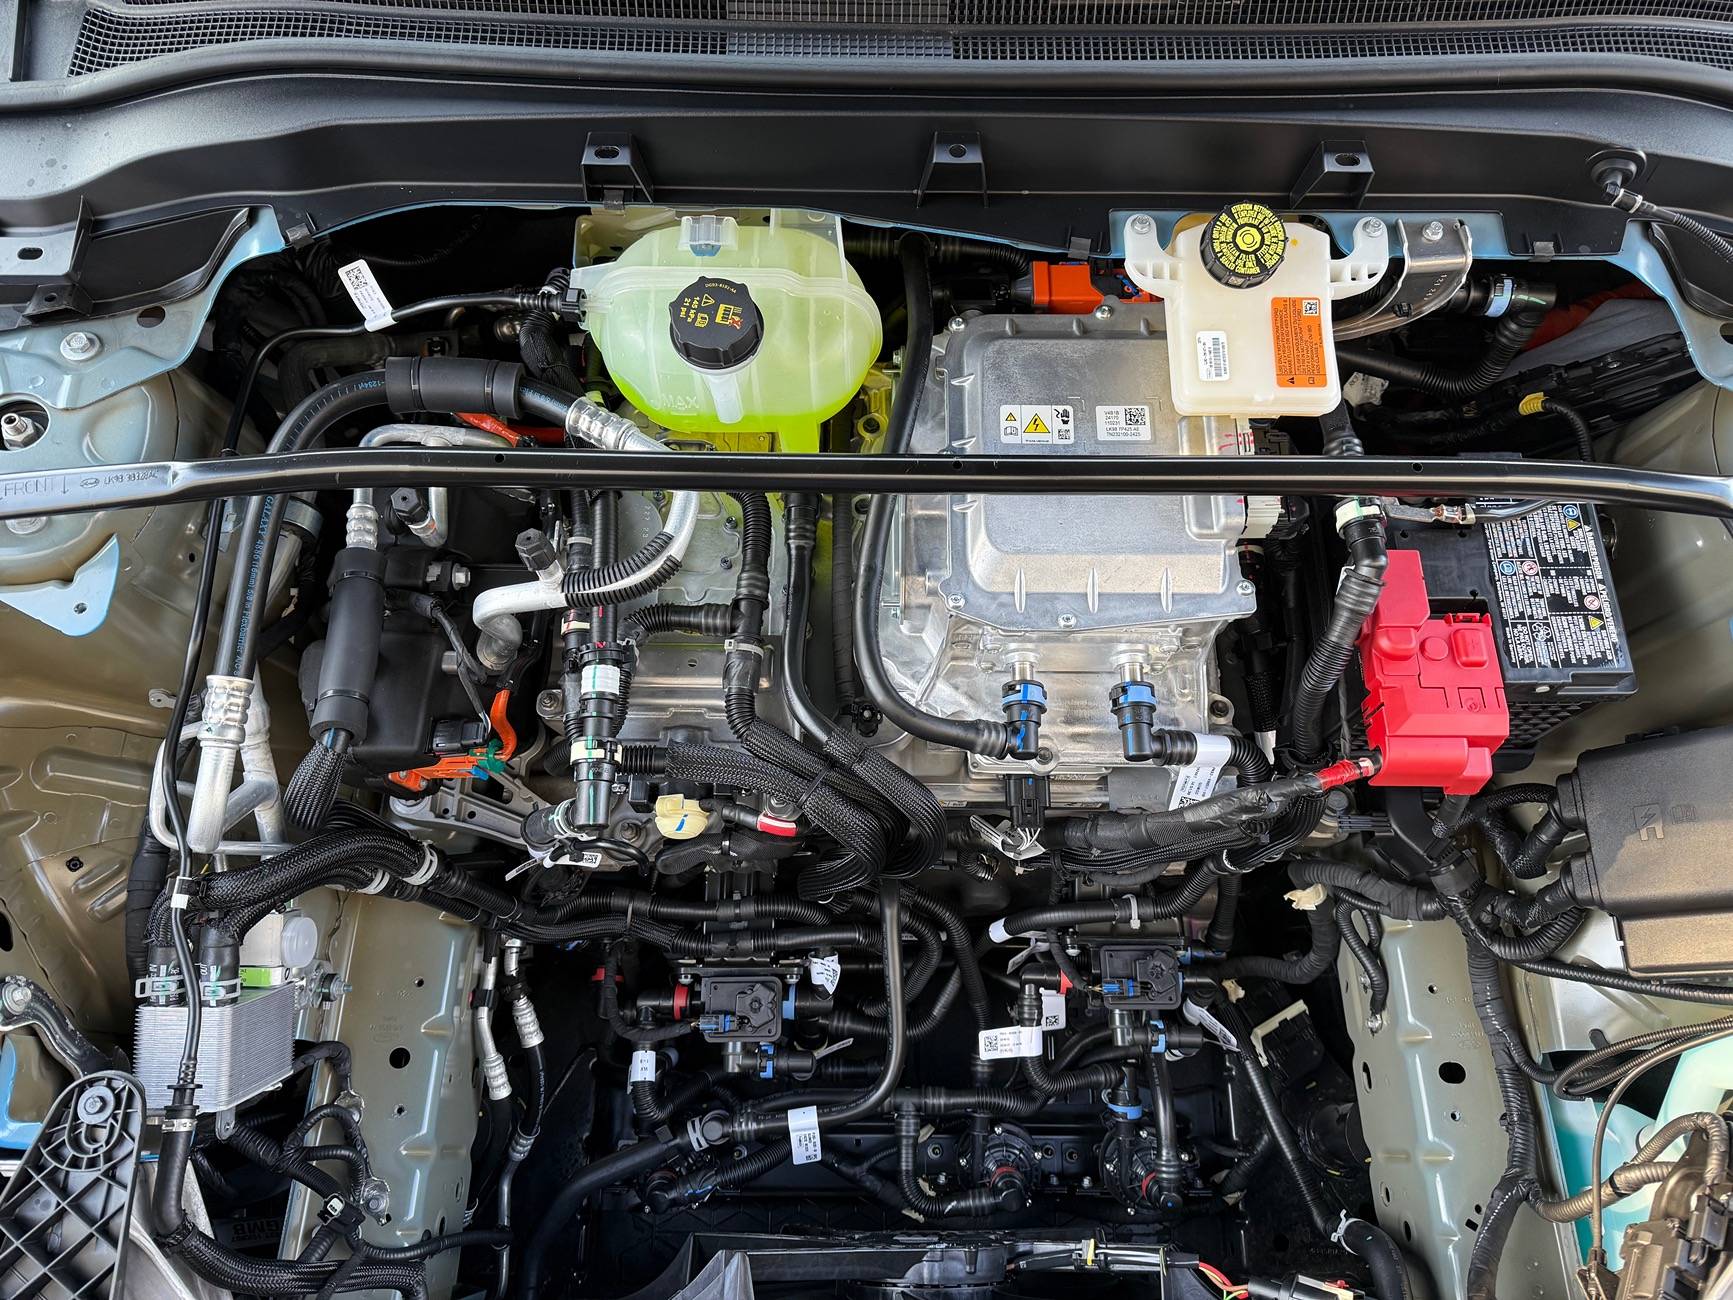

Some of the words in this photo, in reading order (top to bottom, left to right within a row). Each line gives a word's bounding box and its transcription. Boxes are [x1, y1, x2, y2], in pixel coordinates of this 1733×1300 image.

[1230, 203, 1252, 214] ATTENTION
[1253, 204, 1273, 218] NETTOYER
[1273, 220, 1284, 240] BOUCHON
[683, 297, 690, 306] 21
[691, 295, 700, 309] 145
[687, 308, 696, 322] kPa
[4, 477, 55, 496] FRONT
[257, 495, 273, 538] GALAXY
[252, 539, 264, 560] 4886
